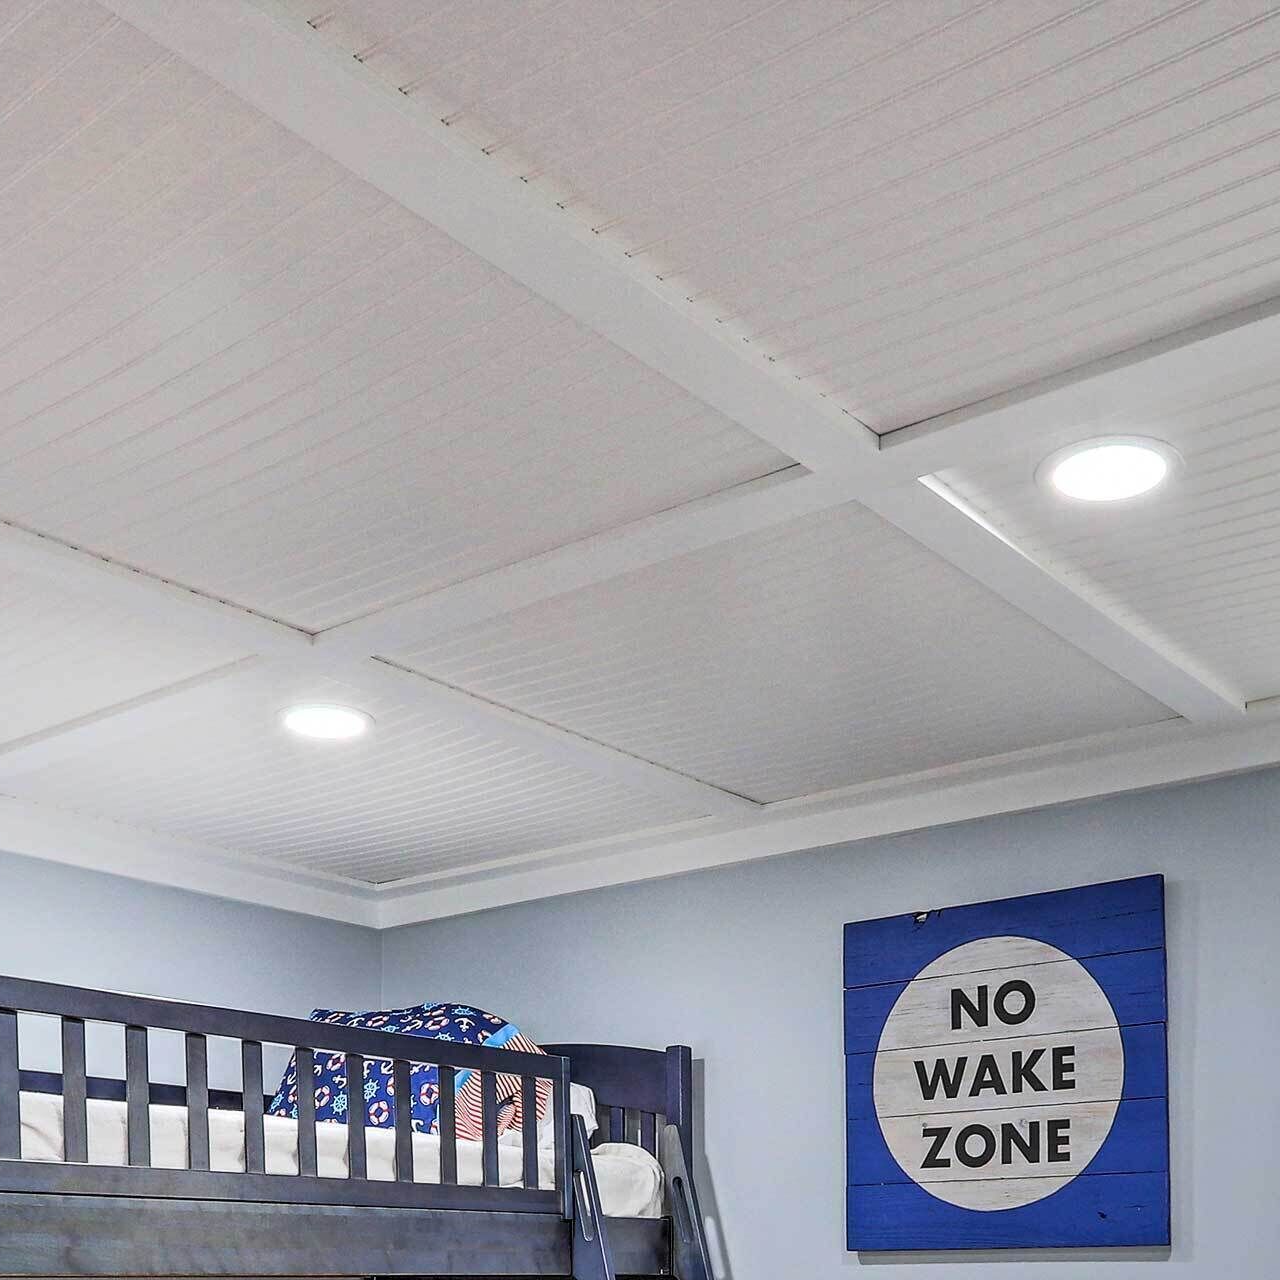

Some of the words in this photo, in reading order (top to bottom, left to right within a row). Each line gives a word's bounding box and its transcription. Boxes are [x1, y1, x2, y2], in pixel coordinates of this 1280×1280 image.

[950, 979, 1036, 1030] NO
[913, 1045, 1076, 1101] WAKE
[920, 1118, 1071, 1169] ZONE
